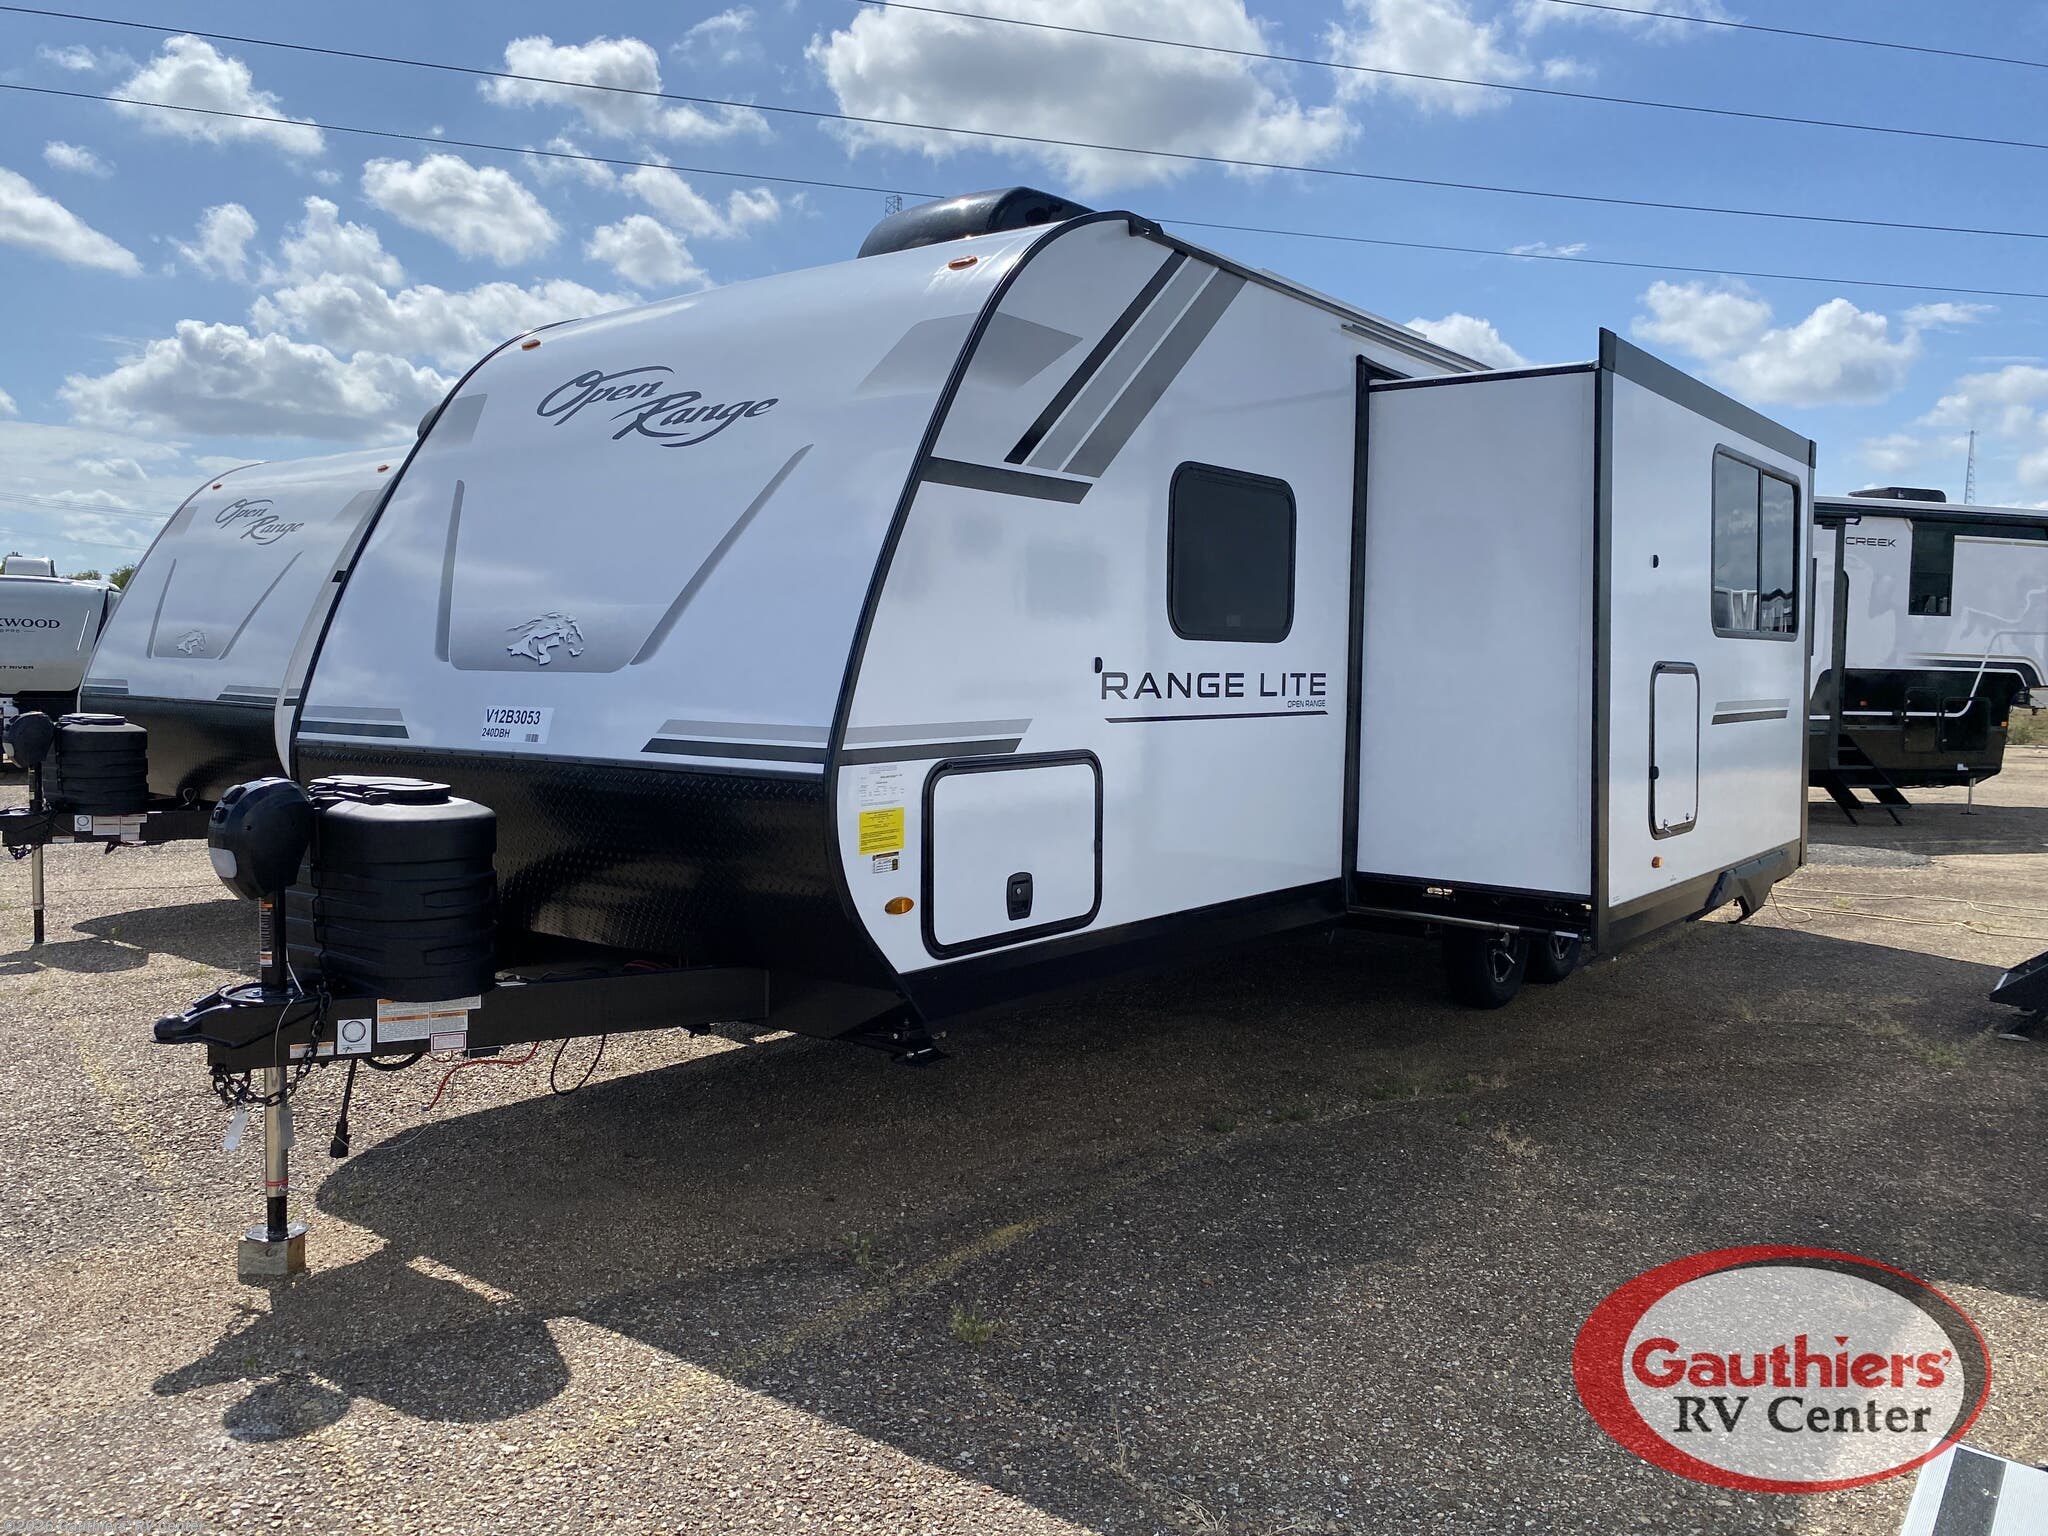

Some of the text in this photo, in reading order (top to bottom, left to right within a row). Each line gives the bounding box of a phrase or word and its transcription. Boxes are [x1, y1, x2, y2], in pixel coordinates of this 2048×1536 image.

[537, 366, 675, 426] Open
[609, 391, 779, 447] Range
[215, 499, 274, 529] Open
[240, 515, 305, 545] Range
[1846, 536, 1896, 547] CREEK
[1101, 672, 1327, 700] RANGE LITE
[486, 708, 541, 725] V12B3053
[1287, 699, 1326, 708] OPEN RANGE
[481, 727, 511, 738] 240DBH
